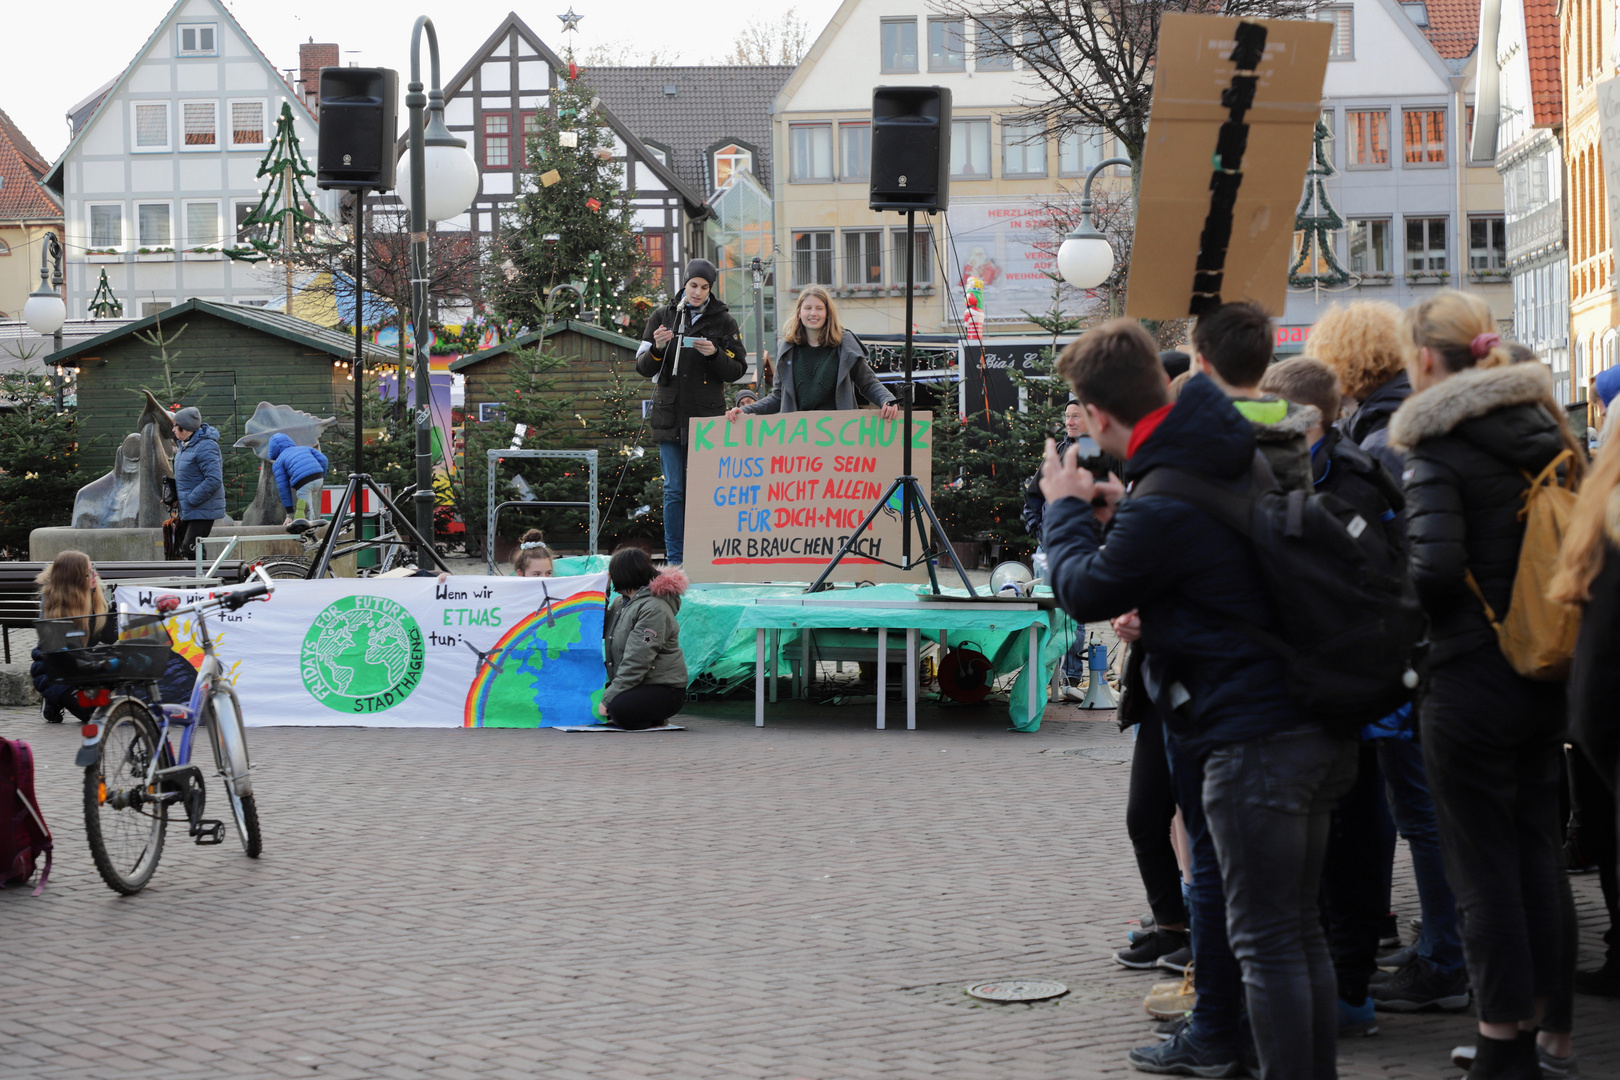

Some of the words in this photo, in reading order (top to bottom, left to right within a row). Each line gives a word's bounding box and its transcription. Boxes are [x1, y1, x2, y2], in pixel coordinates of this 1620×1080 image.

[988, 208, 1043, 217] HERZLICH
[976, 353, 1015, 369] Bia's
[694, 415, 931, 452] KLIMASCHUTZ
[718, 456, 765, 479] MUSS
[770, 455, 823, 474] MUTIG
[833, 455, 876, 473] SEIN
[713, 485, 761, 507] GEHT
[767, 479, 820, 502] NICHT
[822, 478, 882, 500] ALLEIN
[737, 507, 771, 532] FÜR
[712, 538, 742, 557] WIR
[747, 537, 834, 557] BRAUCHEN
[436, 584, 468, 600] Wenn
[473, 585, 493, 599] wir
[315, 604, 343, 628] FOR
[355, 596, 410, 625] FUTURE
[443, 607, 501, 627] ETWAS
[428, 631, 462, 647] tun:
[302, 640, 331, 700] FRIDAYS
[353, 641, 423, 712] STADTHAGEN
